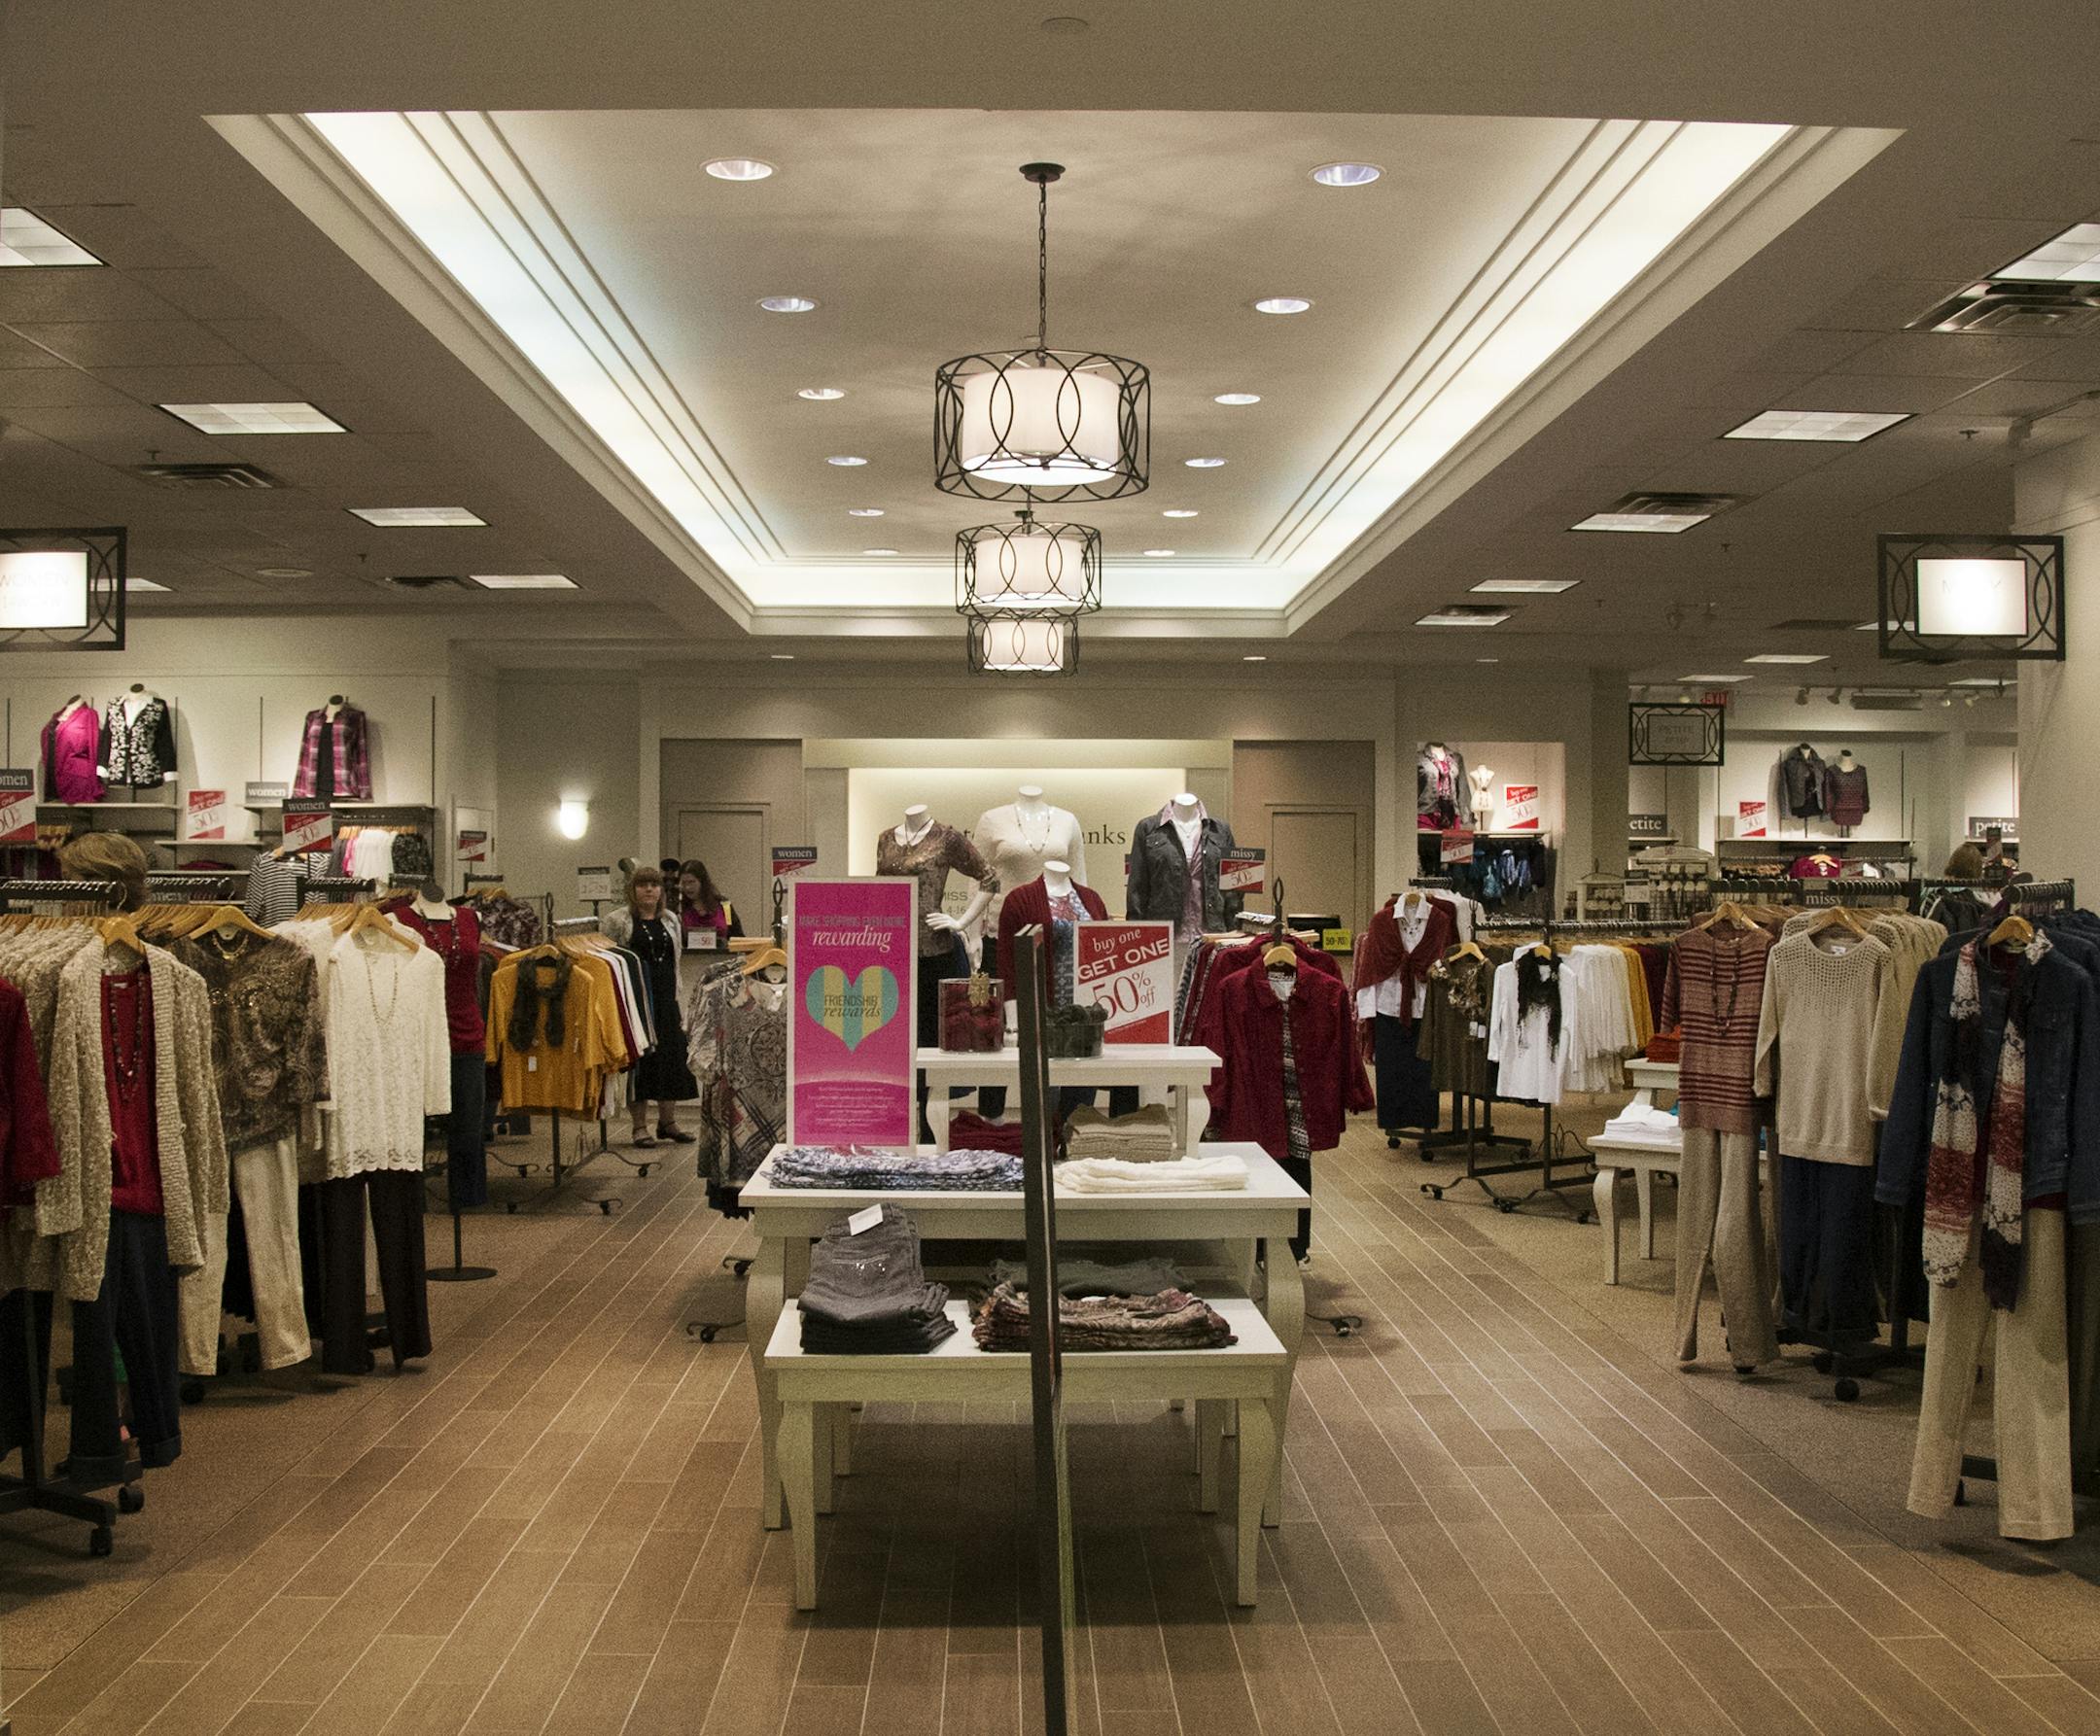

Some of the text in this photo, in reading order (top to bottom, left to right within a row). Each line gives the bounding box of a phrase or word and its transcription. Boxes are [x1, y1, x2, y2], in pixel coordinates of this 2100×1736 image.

[248, 787, 286, 796] women
[288, 802, 326, 812] women
[1628, 816, 1662, 830] etite
[778, 850, 813, 858] women
[1230, 848, 1256, 860] missy
[813, 925, 892, 953] rewarding
[1093, 928, 1142, 955] buy one
[1079, 938, 1171, 980] GET ONE
[1139, 986, 1156, 1008] off
[823, 1005, 881, 1018] rewards
